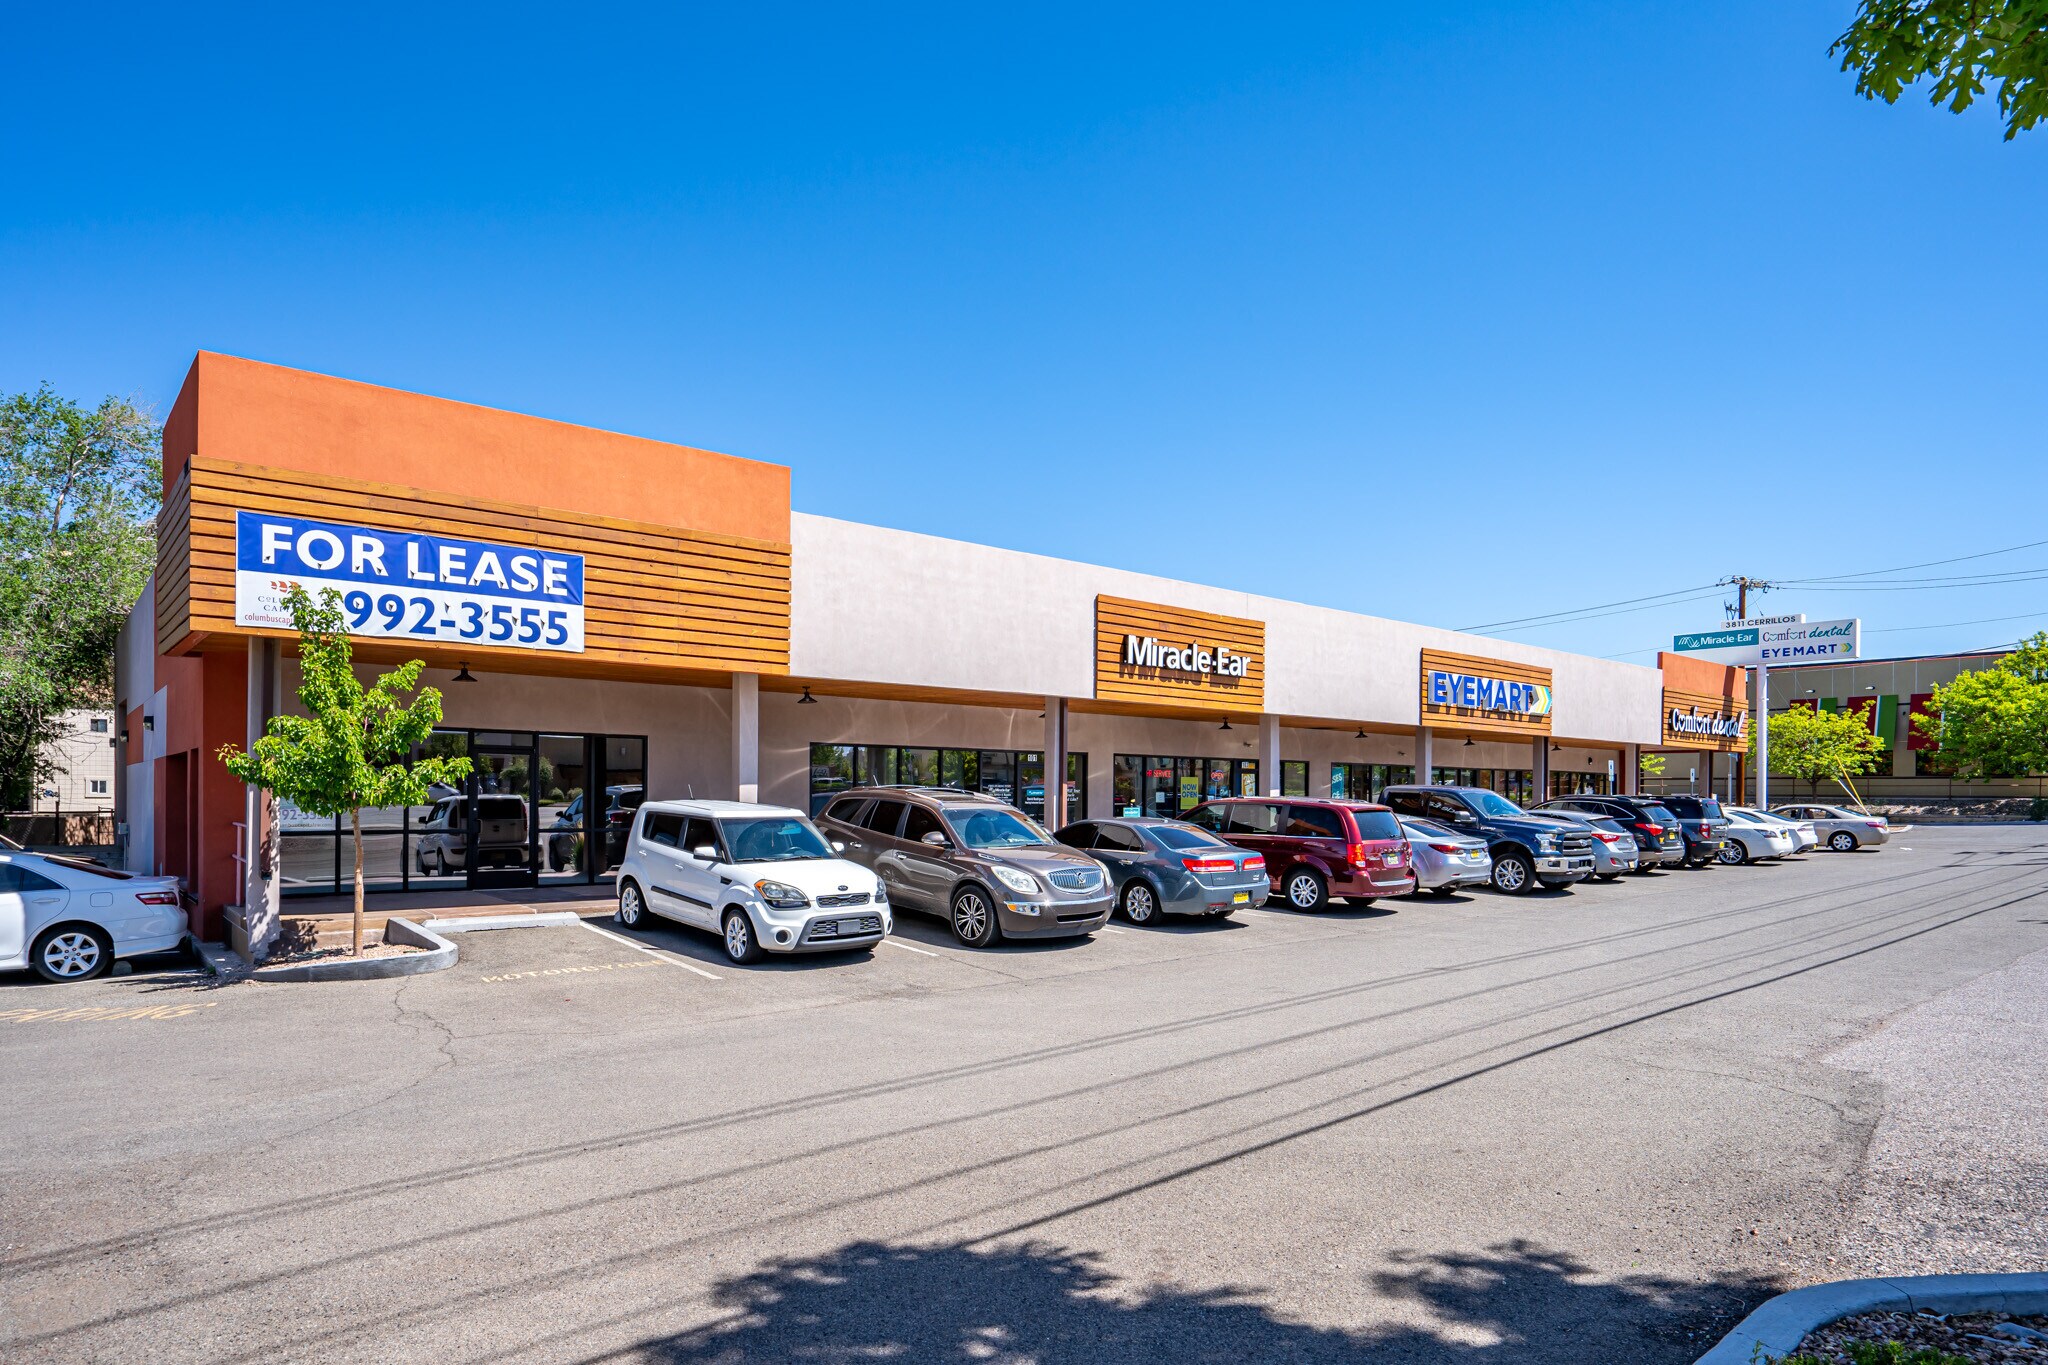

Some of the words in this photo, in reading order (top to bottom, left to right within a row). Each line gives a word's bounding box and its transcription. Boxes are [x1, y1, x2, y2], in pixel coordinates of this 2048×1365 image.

[261, 523, 389, 577] FOR
[407, 542, 568, 596] LEASE
[344, 590, 569, 646] 992-3555
[1725, 620, 1745, 629] 3811
[1747, 615, 1796, 627] CERRILLOS
[1762, 628, 1807, 643] Comfort
[1808, 622, 1854, 639] dental
[1127, 634, 1251, 678] Miracle-Ear
[1762, 643, 1838, 659] EYEMART
[1433, 671, 1534, 713] EYEMART
[1672, 705, 1711, 735] Comfort
[1711, 710, 1746, 738] dental
[1210, 771, 1225, 780] OPEN
[1181, 791, 1198, 799] OPEN
[1182, 783, 1197, 791] NOW
